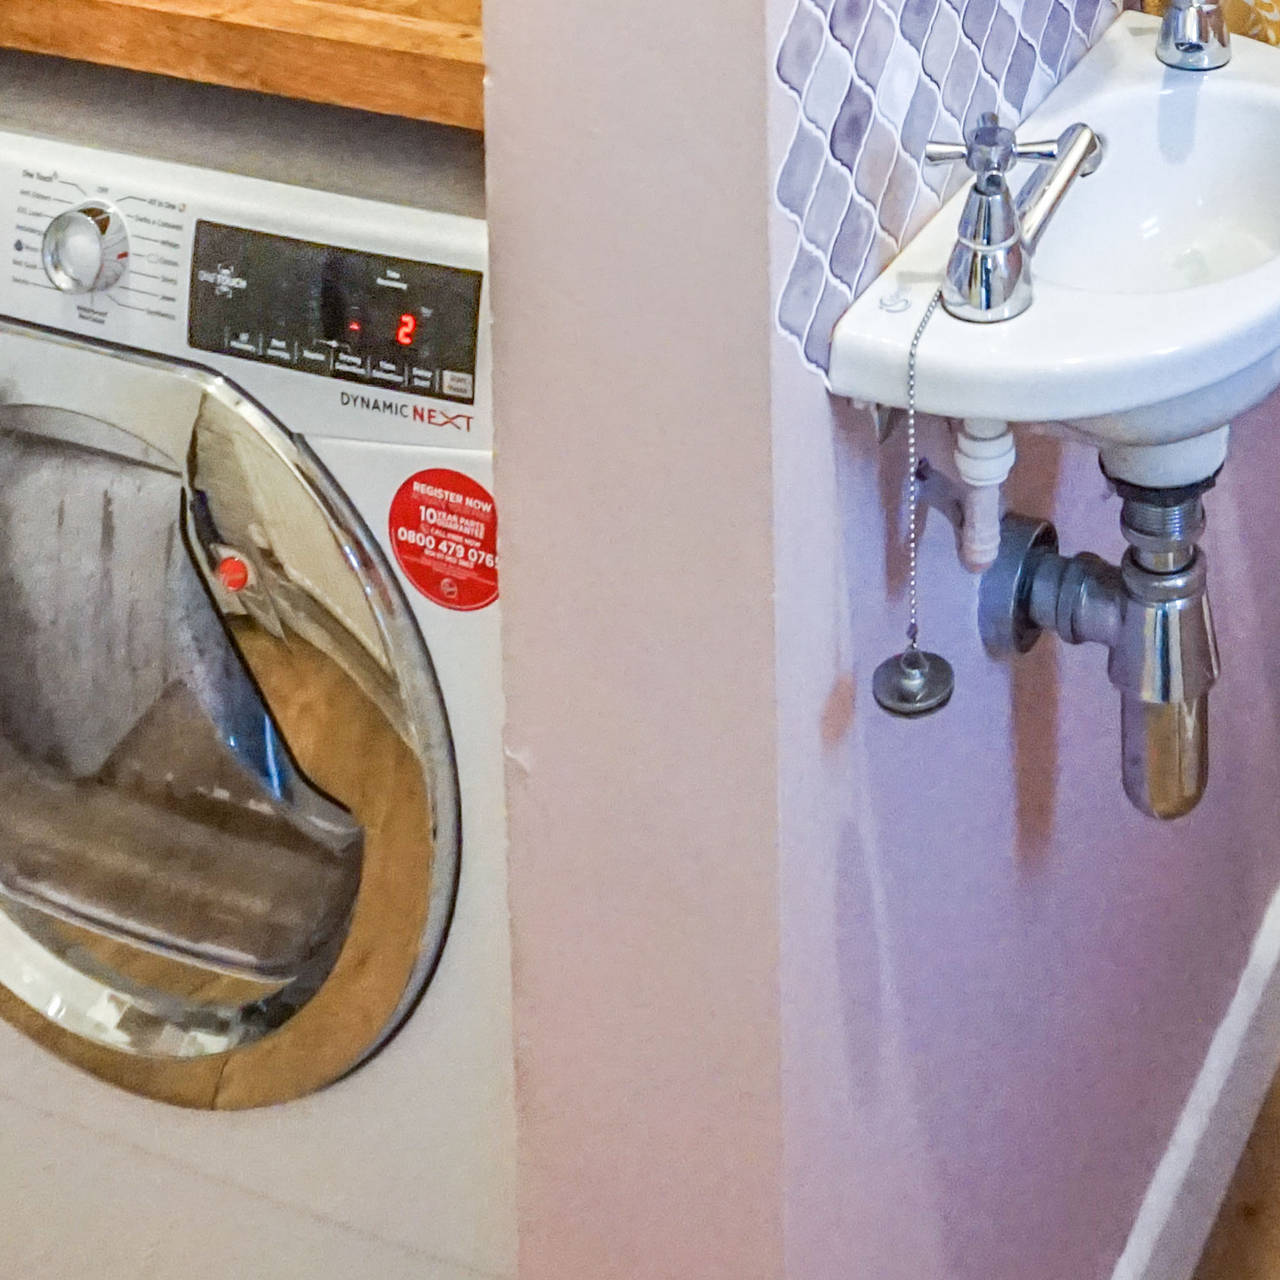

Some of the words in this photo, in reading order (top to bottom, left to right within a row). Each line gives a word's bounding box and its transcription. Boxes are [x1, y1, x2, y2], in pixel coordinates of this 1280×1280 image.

[396, 313, 416, 346] 2
[340, 391, 409, 418] DYNAMIC
[412, 404, 474, 432] NEXT
[413, 481, 463, 504] REGISTER
[465, 496, 492, 513] NOW
[419, 505, 437, 525] 10
[397, 526, 436, 550] 0800
[438, 540, 465, 559] 479
